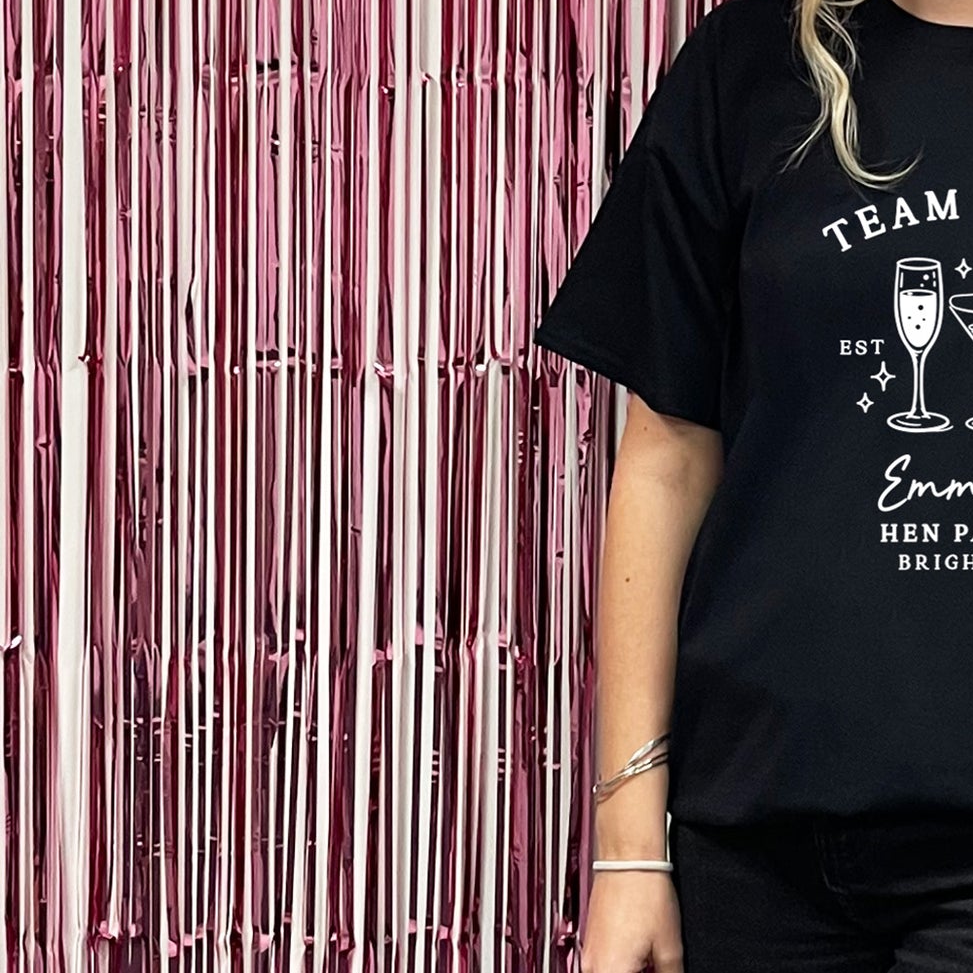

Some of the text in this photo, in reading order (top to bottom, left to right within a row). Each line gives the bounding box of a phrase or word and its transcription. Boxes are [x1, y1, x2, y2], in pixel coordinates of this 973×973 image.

[821, 188, 960, 253] TEAM
[839, 338, 885, 356] EST
[880, 522, 941, 543] HEN
